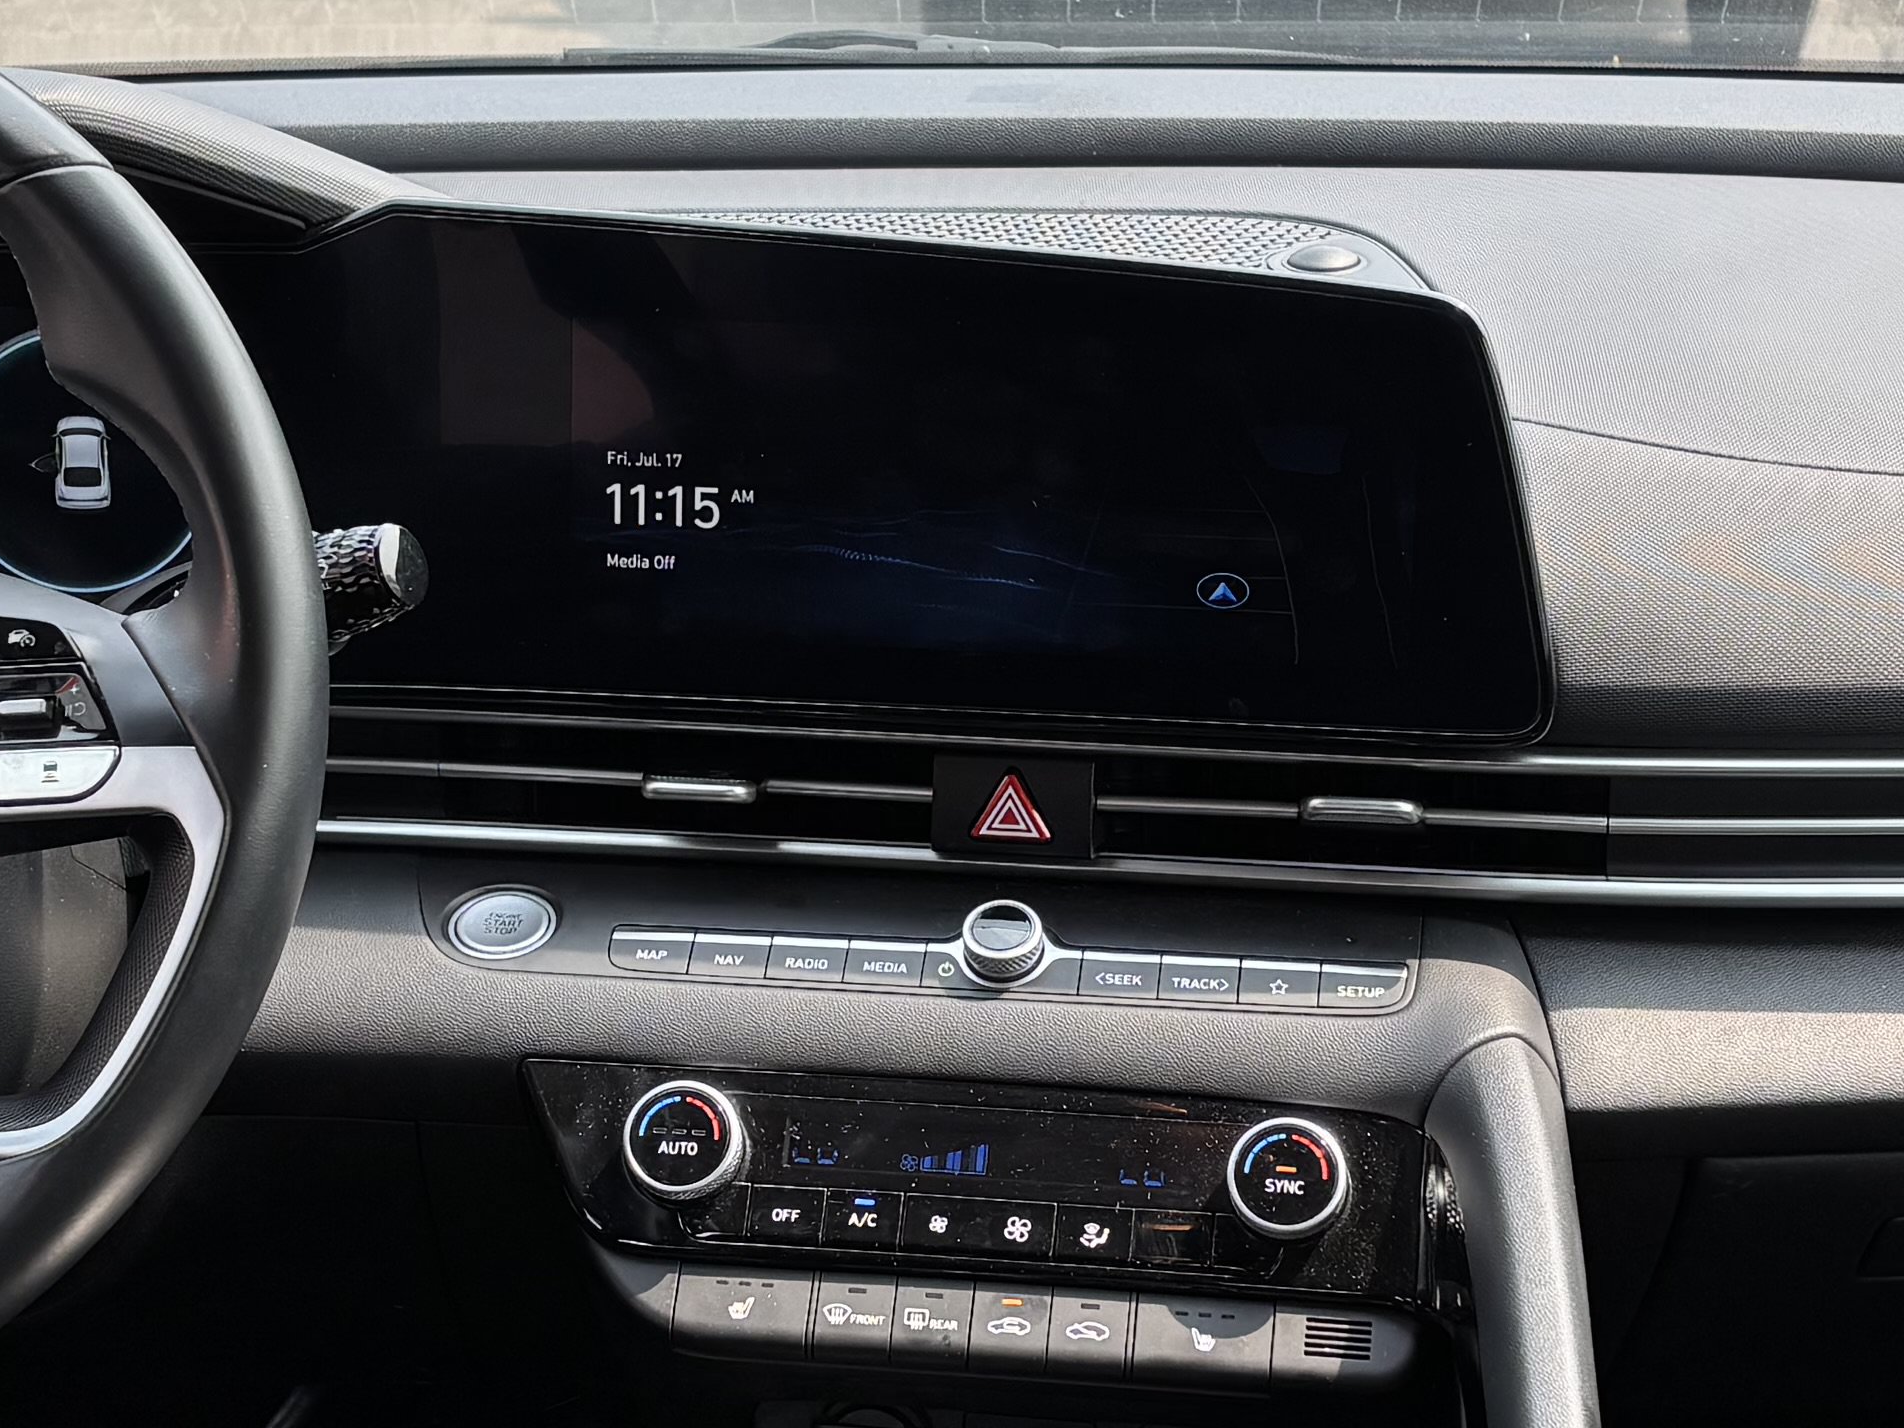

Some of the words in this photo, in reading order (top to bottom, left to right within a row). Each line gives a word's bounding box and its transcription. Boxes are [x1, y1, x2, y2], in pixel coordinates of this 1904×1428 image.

[607, 450, 632, 467] Fri,
[635, 451, 662, 468] Jul.
[665, 453, 683, 468] 17
[605, 482, 721, 530] 11:15
[730, 488, 755, 504] AM
[606, 552, 650, 569] Media
[653, 554, 676, 570] Off
[483, 917, 524, 928] START
[483, 926, 518, 935] STOP
[635, 948, 668, 960] MAP
[713, 953, 745, 966] NAV
[784, 956, 829, 970] RADIO
[862, 960, 908, 974] MEDIA
[1336, 985, 1386, 999] SETUP
[657, 1140, 699, 1157] AUTO
[1263, 1177, 1306, 1196] SYNC
[771, 1207, 802, 1224] OFF
[847, 1211, 879, 1229] A/C
[849, 1313, 886, 1328] FRONT
[928, 1318, 959, 1332] REAR
